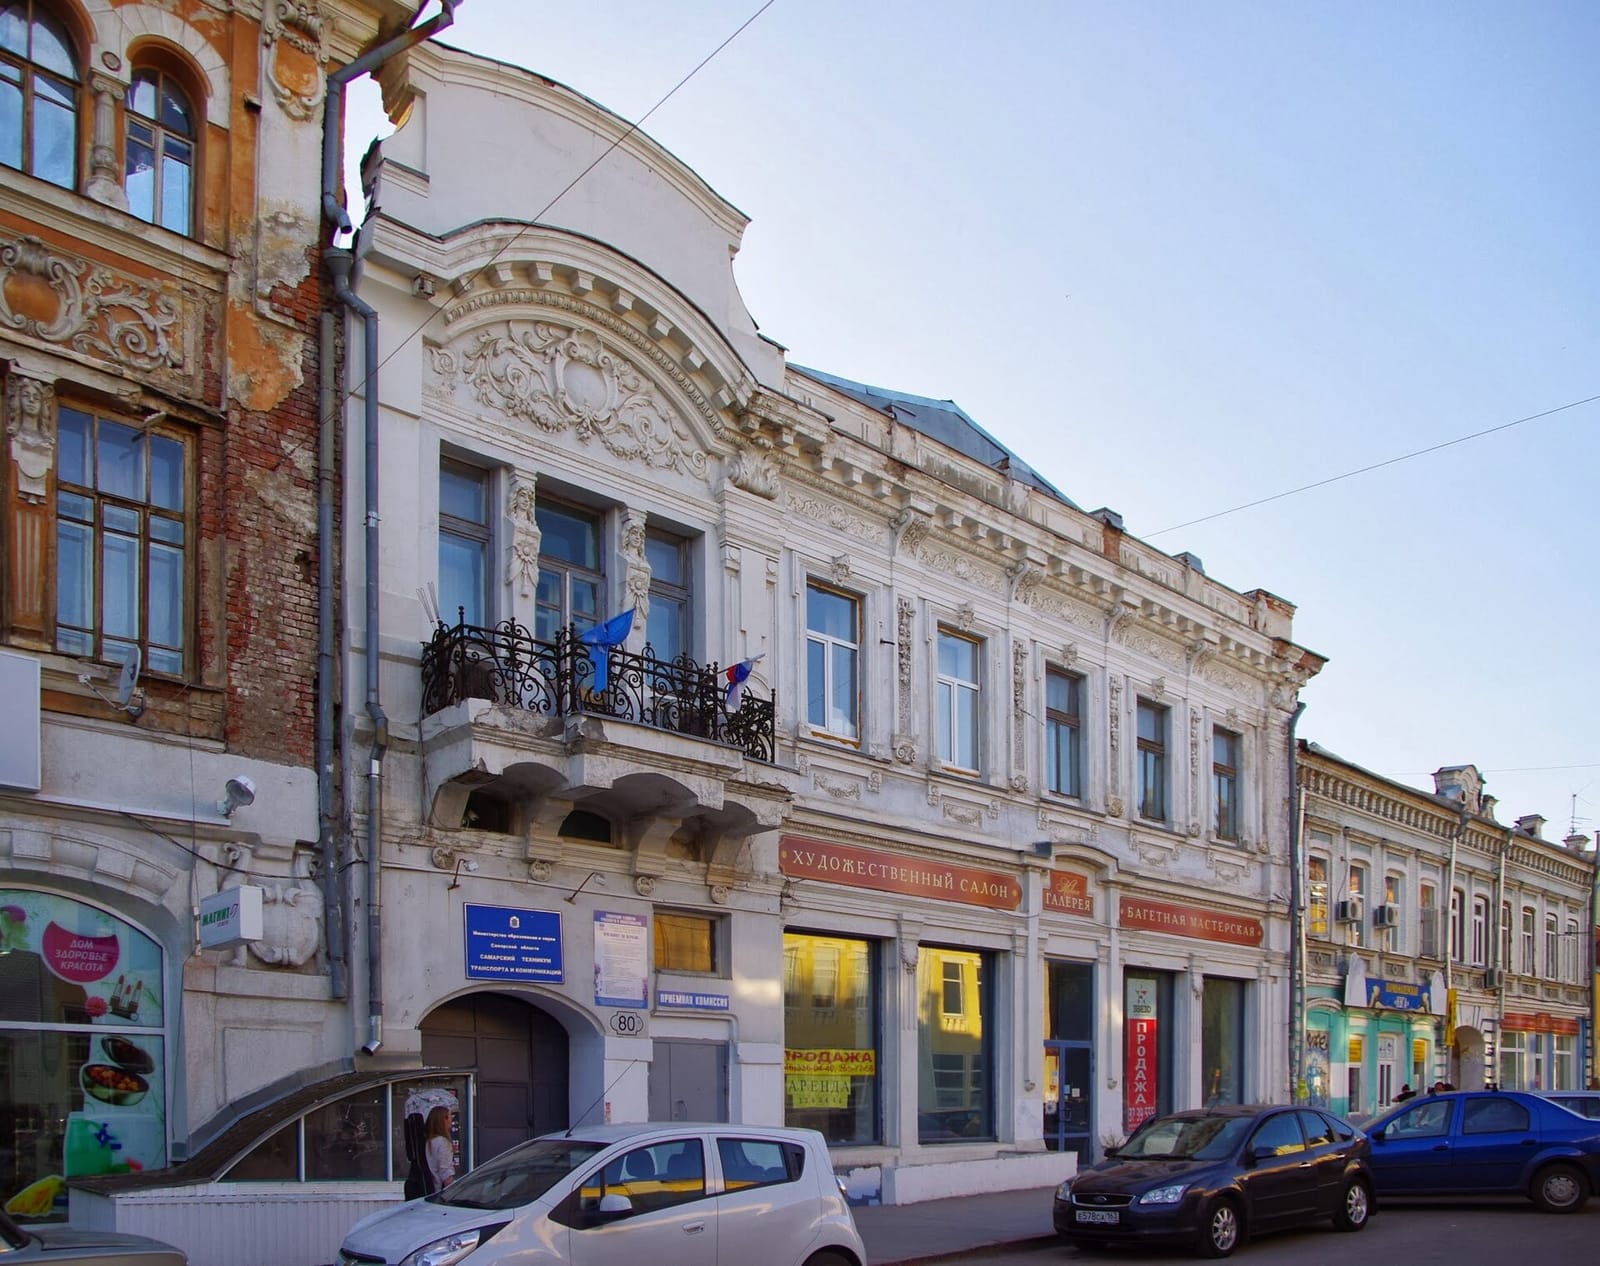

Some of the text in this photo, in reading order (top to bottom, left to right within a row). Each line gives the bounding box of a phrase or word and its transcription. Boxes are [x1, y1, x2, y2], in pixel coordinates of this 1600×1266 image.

[793, 850, 1008, 898] ХУДОЖЕСТВЕННЫЙ САЛОН
[1046, 892, 1091, 911] ГАЛЕРЕЯ
[1127, 906, 1256, 937] БАГЕТНАЯ МАСТЕРСКАЯ
[70, 940, 94, 950] ДОМ
[55, 949, 109, 962] ЗДОРОВЬЕ
[480, 954, 552, 964] САМАРСКИЙ ТЕХНИКУМ
[60, 961, 104, 973] КРАСОТА
[470, 965, 509, 973] ТРАНСПОРТА
[515, 967, 562, 976] КОММУНИКАЦИЙ
[660, 993, 728, 1008] ПРИЕМНАЯ КОМИССИЯ
[618, 1015, 636, 1032] 80
[1134, 1021, 1148, 1105] ПРОДАЖА
[788, 1080, 850, 1094] АРЕНДА
